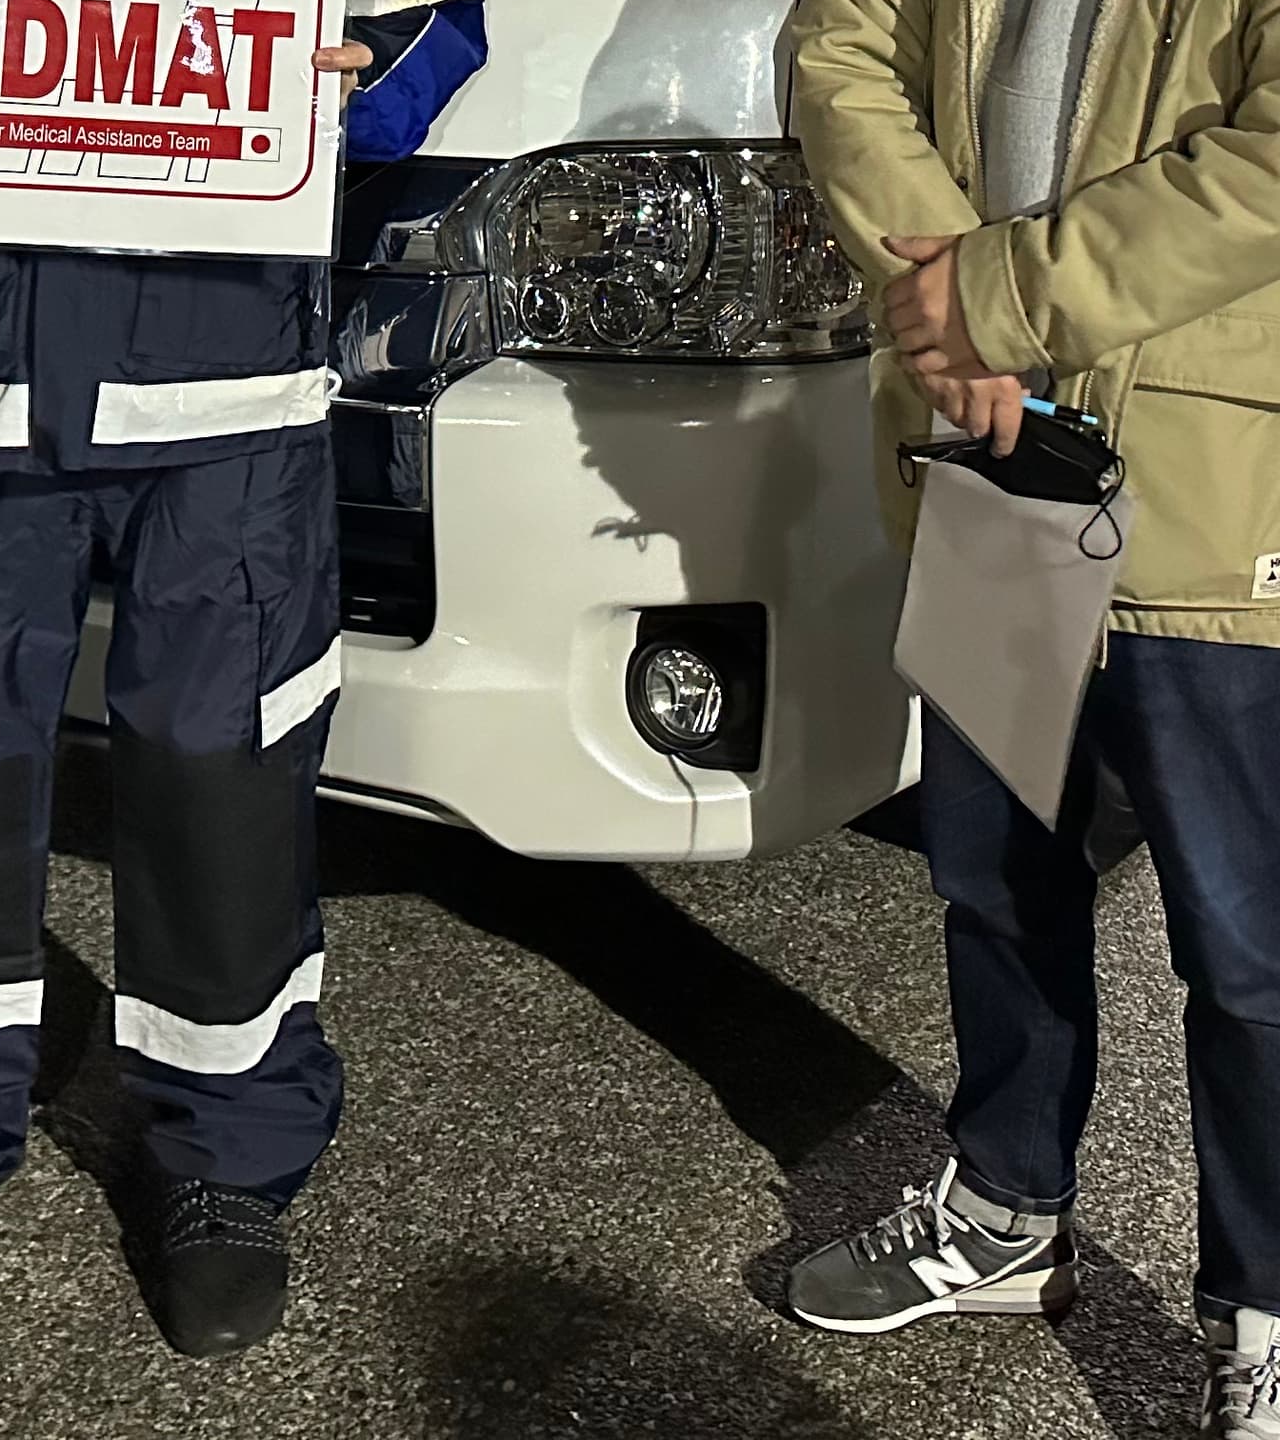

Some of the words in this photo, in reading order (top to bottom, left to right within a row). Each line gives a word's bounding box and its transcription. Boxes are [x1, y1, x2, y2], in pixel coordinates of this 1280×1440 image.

[8, 121, 72, 144] Medical
[74, 125, 163, 149] Assistance
[167, 131, 211, 152] Team
